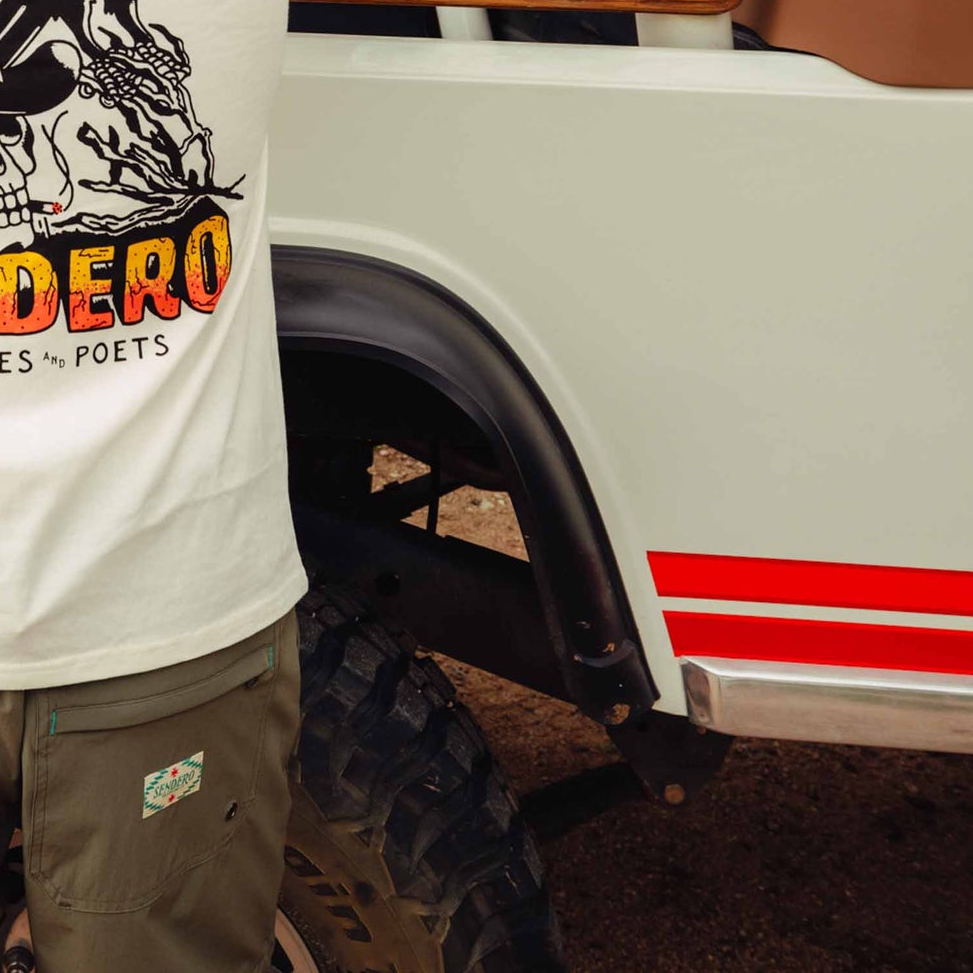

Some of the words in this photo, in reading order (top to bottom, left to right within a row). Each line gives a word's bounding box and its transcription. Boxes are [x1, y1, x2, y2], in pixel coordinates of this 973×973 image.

[42, 351, 66, 369] AND
[75, 333, 170, 367] POETS
[153, 769, 196, 800] SENDERO
